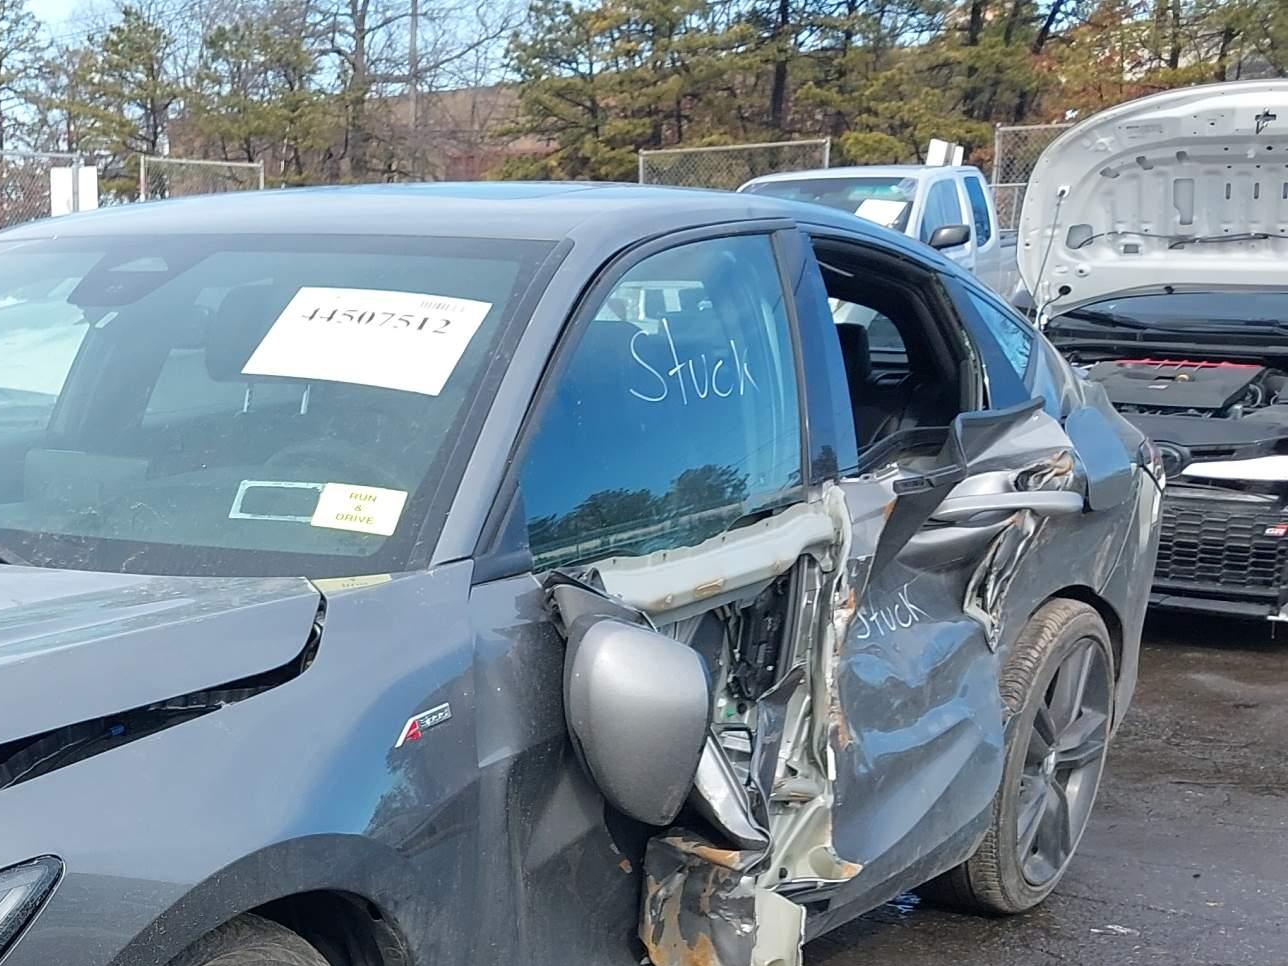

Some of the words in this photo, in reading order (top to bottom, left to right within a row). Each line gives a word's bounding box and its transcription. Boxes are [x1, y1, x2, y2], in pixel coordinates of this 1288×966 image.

[301, 307, 452, 334] 44507512
[628, 317, 761, 405] Stuck
[349, 492, 377, 503] RUN
[354, 504, 363, 512] &
[335, 513, 376, 525] DRIVE
